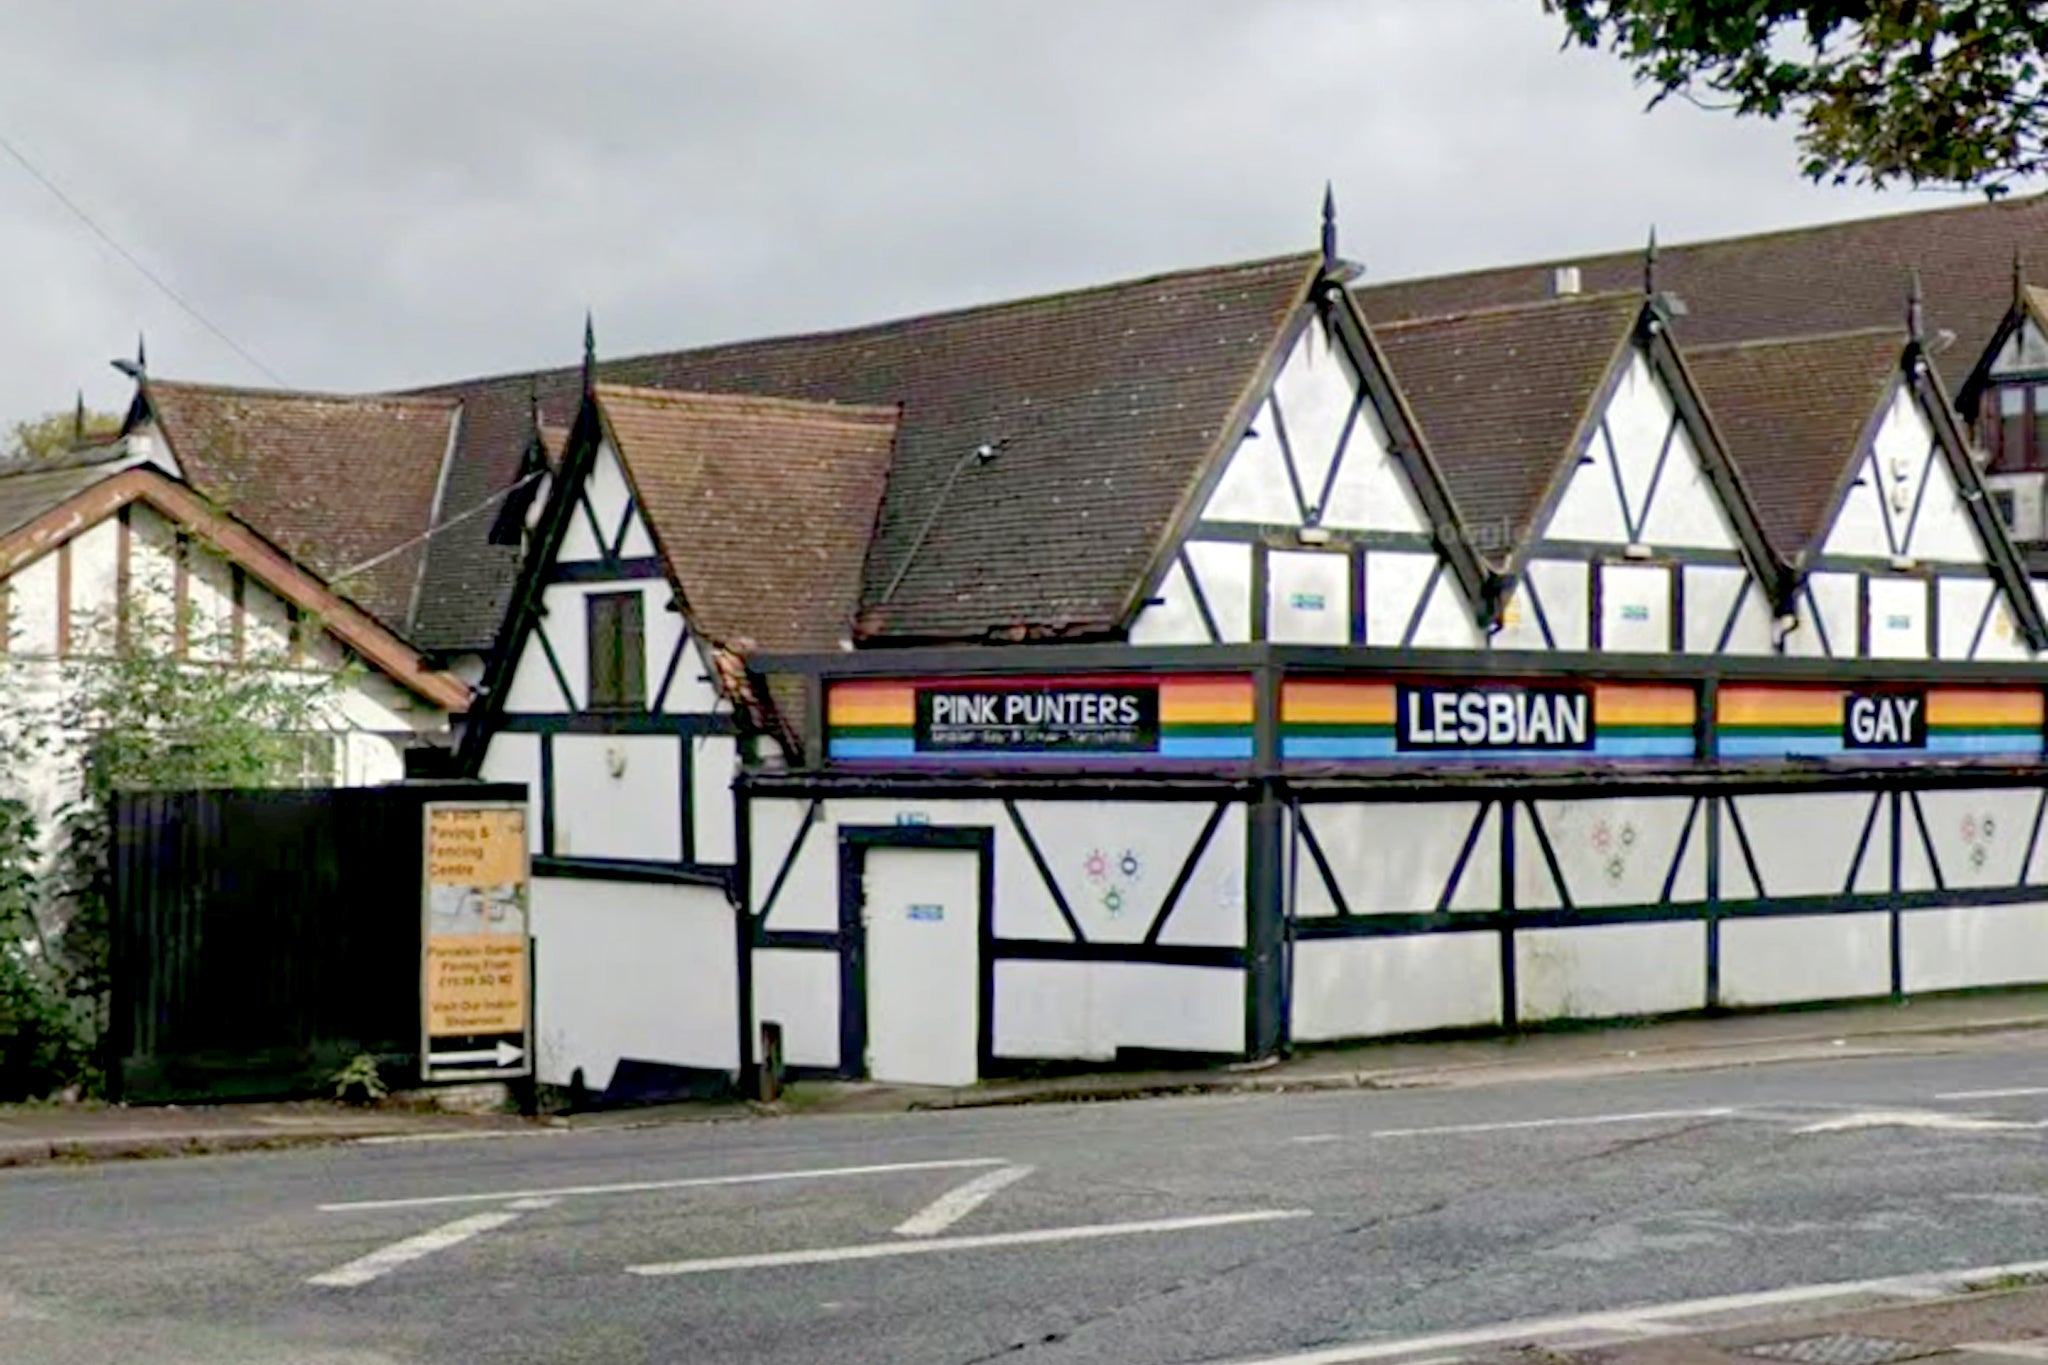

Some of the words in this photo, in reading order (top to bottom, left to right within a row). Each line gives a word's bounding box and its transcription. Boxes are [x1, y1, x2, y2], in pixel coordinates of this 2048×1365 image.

[932, 694, 998, 724] PINK
[1005, 693, 1139, 725] PUNTERS
[1408, 691, 1587, 744] LESBIAN
[1850, 697, 1918, 743] GAY
[430, 844, 483, 860] Fencing
